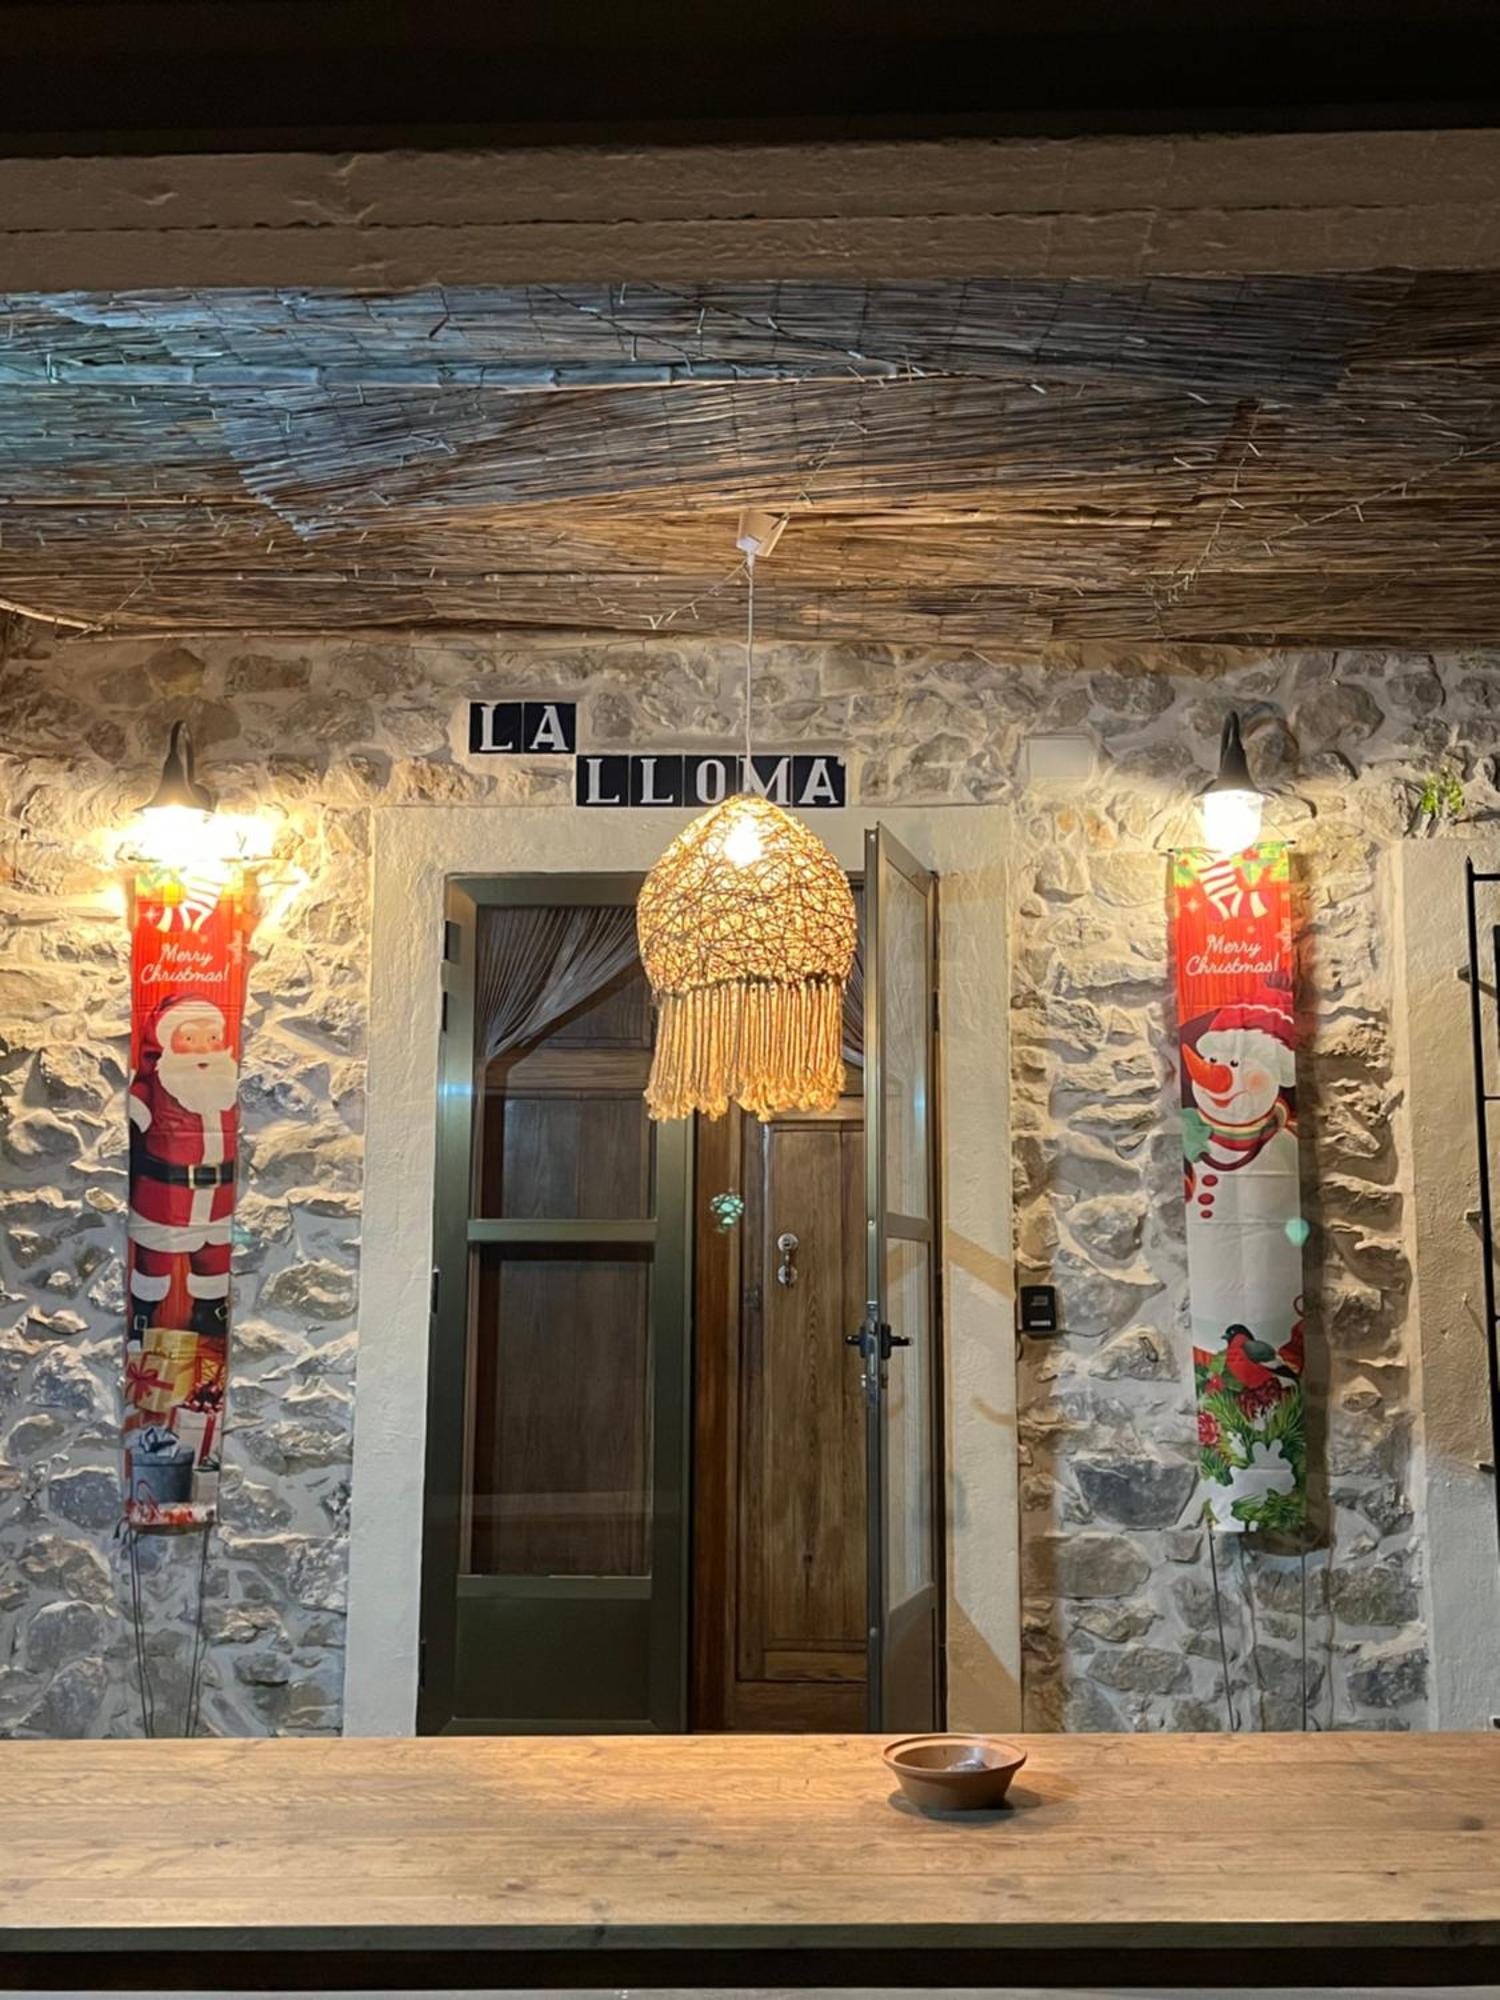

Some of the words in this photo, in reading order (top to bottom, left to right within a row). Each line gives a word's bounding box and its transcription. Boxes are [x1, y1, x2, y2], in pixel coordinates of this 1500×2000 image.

[480, 704, 569, 752] LA
[586, 758, 839, 804] LLOMA
[160, 943, 213, 967] Merry
[1205, 934, 1261, 958] Merry
[141, 962, 230, 984] Christmas!
[1186, 953, 1280, 976] Christmas!
